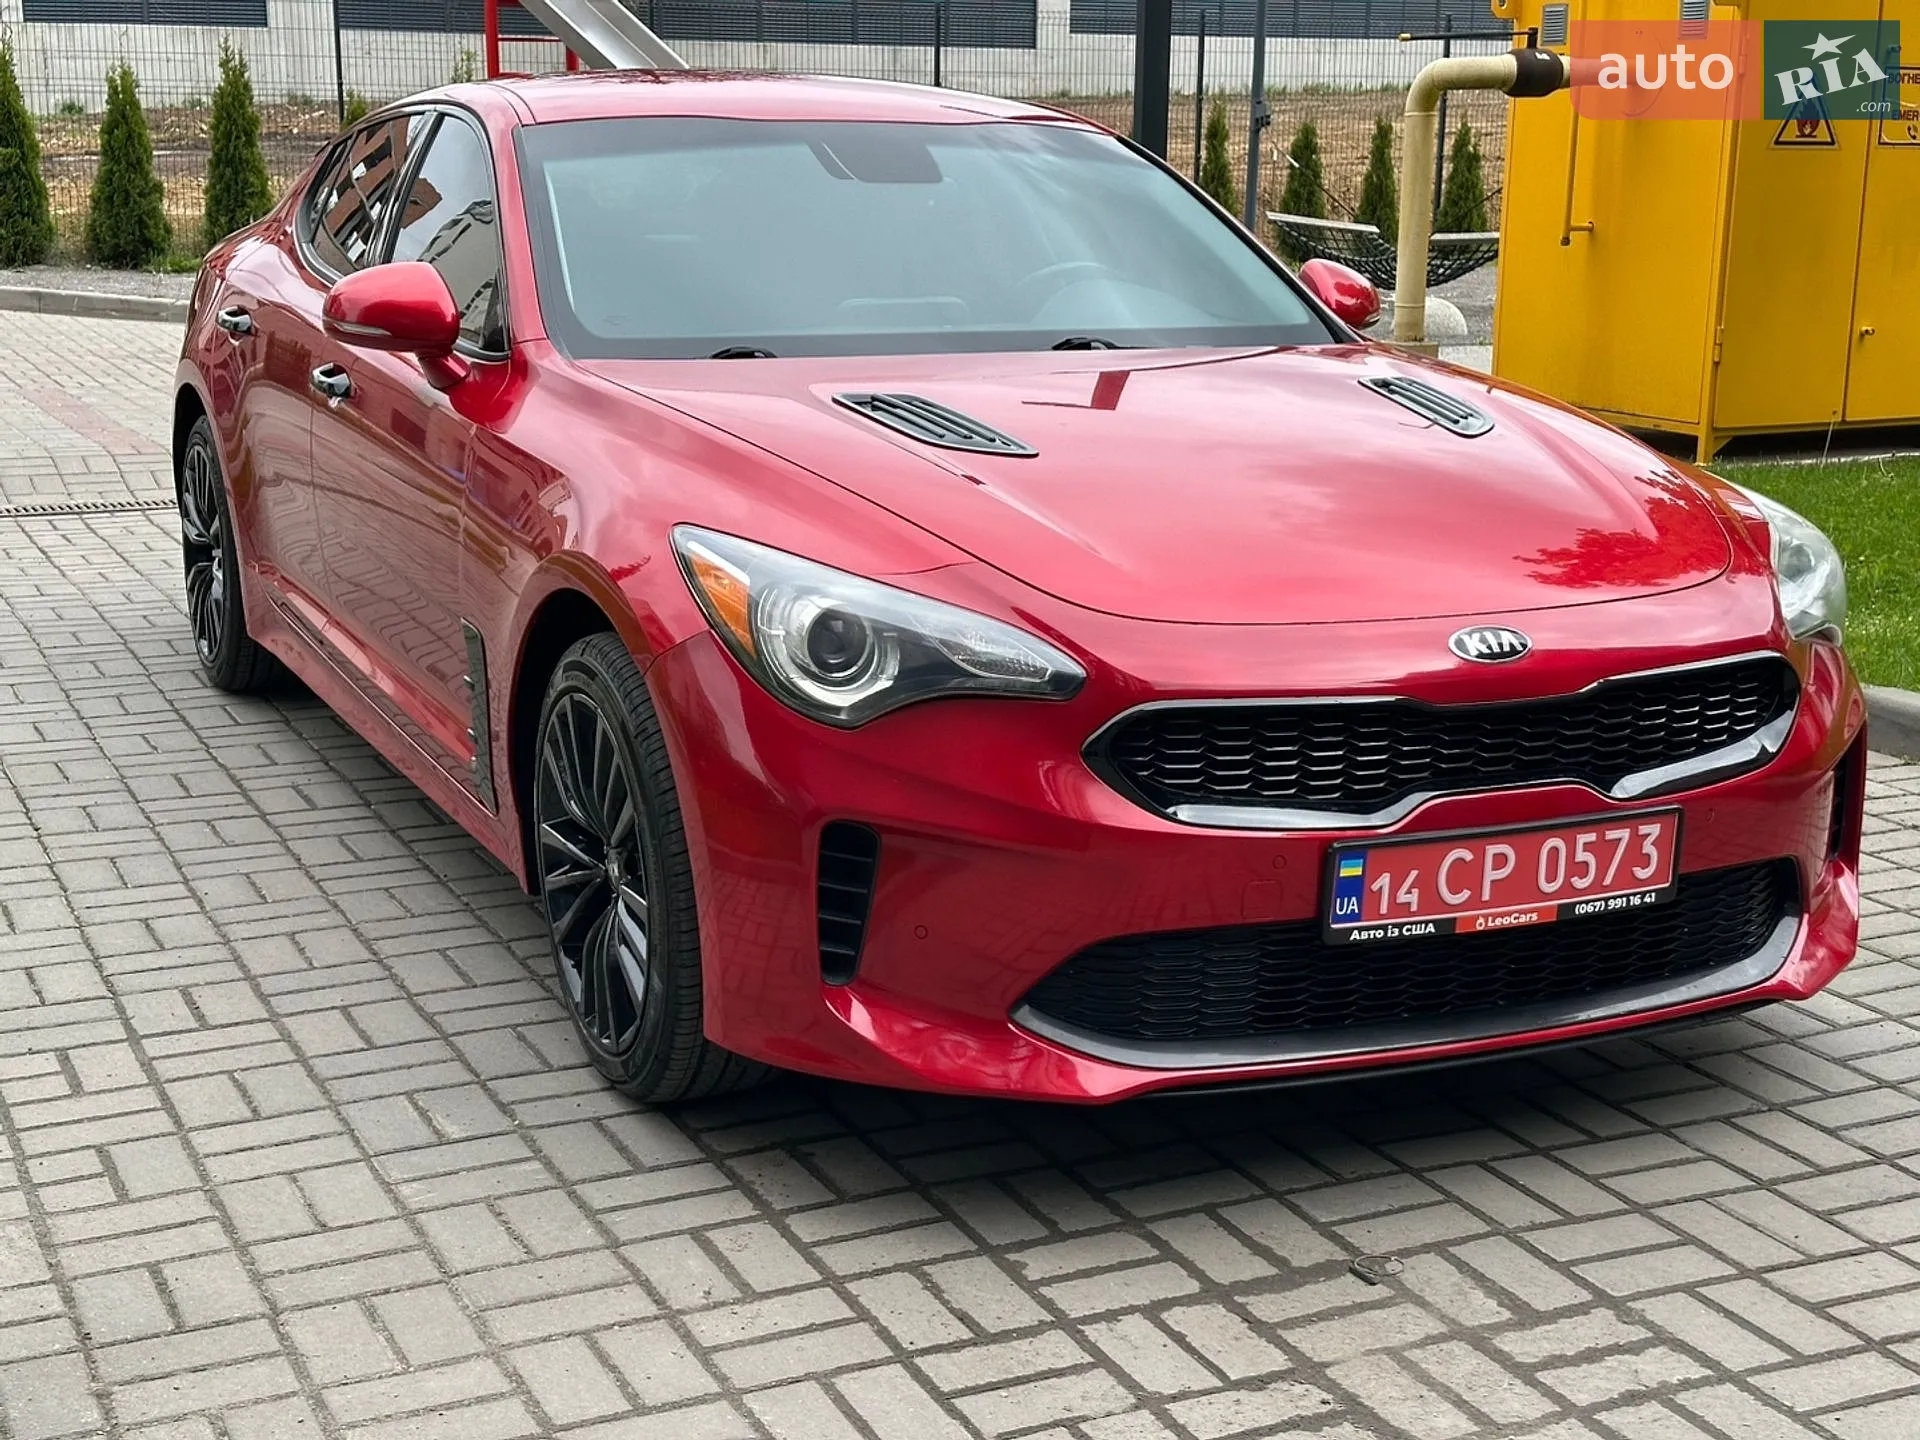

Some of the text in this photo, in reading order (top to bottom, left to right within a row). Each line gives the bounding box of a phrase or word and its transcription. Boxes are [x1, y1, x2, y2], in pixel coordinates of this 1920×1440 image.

[1459, 630, 1524, 657] KIA
[1370, 823, 1661, 914] 14 CP 0573
[1335, 896, 1359, 915] UA
[1575, 892, 1656, 915] (067) 991 16 41
[1487, 911, 1538, 927] LeoCars
[1350, 922, 1436, 941] Авто із США
